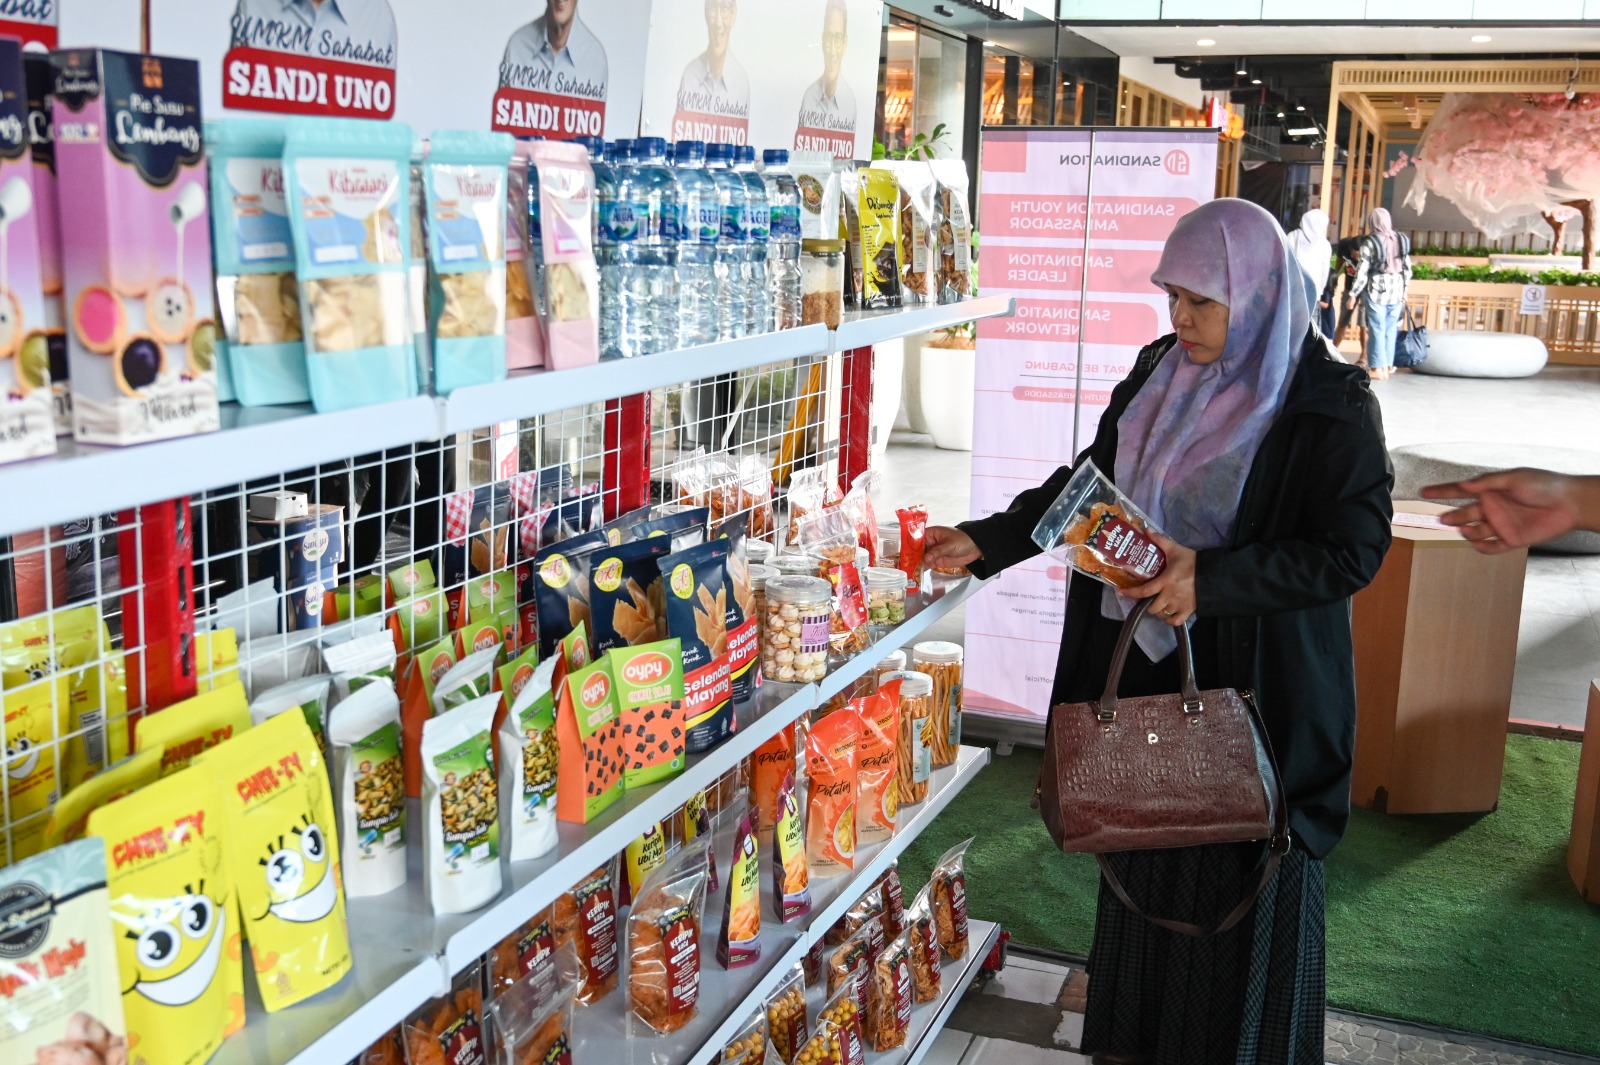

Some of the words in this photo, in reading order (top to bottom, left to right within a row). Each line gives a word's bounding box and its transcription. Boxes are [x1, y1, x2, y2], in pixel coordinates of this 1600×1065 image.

[231, 15, 314, 53] UMKM
[319, 30, 393, 65] Sahabat
[228, 60, 328, 105] SANDI
[334, 75, 391, 112] UNO
[499, 61, 552, 90] UMKM
[555, 72, 605, 98] Sahabat
[129, 93, 152, 113] Pie
[152, 95, 185, 116] Susu
[676, 89, 712, 113] UMKM
[714, 96, 748, 117] Sahabat
[496, 98, 559, 131] SANDI
[564, 107, 602, 136] UNO
[798, 109, 826, 128] UMKM
[828, 113, 855, 131] Sahabat
[115, 110, 201, 153] Lembang
[675, 120, 716, 144] SANDI
[719, 127, 747, 147] UNO
[796, 135, 830, 153] SANDI
[833, 139, 853, 159] UNO
[613, 207, 634, 223] AQUA
[1104, 524, 1123, 551] KERIPIK
[625, 659, 663, 681] oypy
[683, 663, 730, 694] Selendan
[582, 678, 606, 702] oypy
[686, 678, 728, 708] Mayang
[637, 855, 652, 867] Ubi
[587, 899, 609, 921] KERIPIK
[670, 927, 694, 949] KERIPIK
